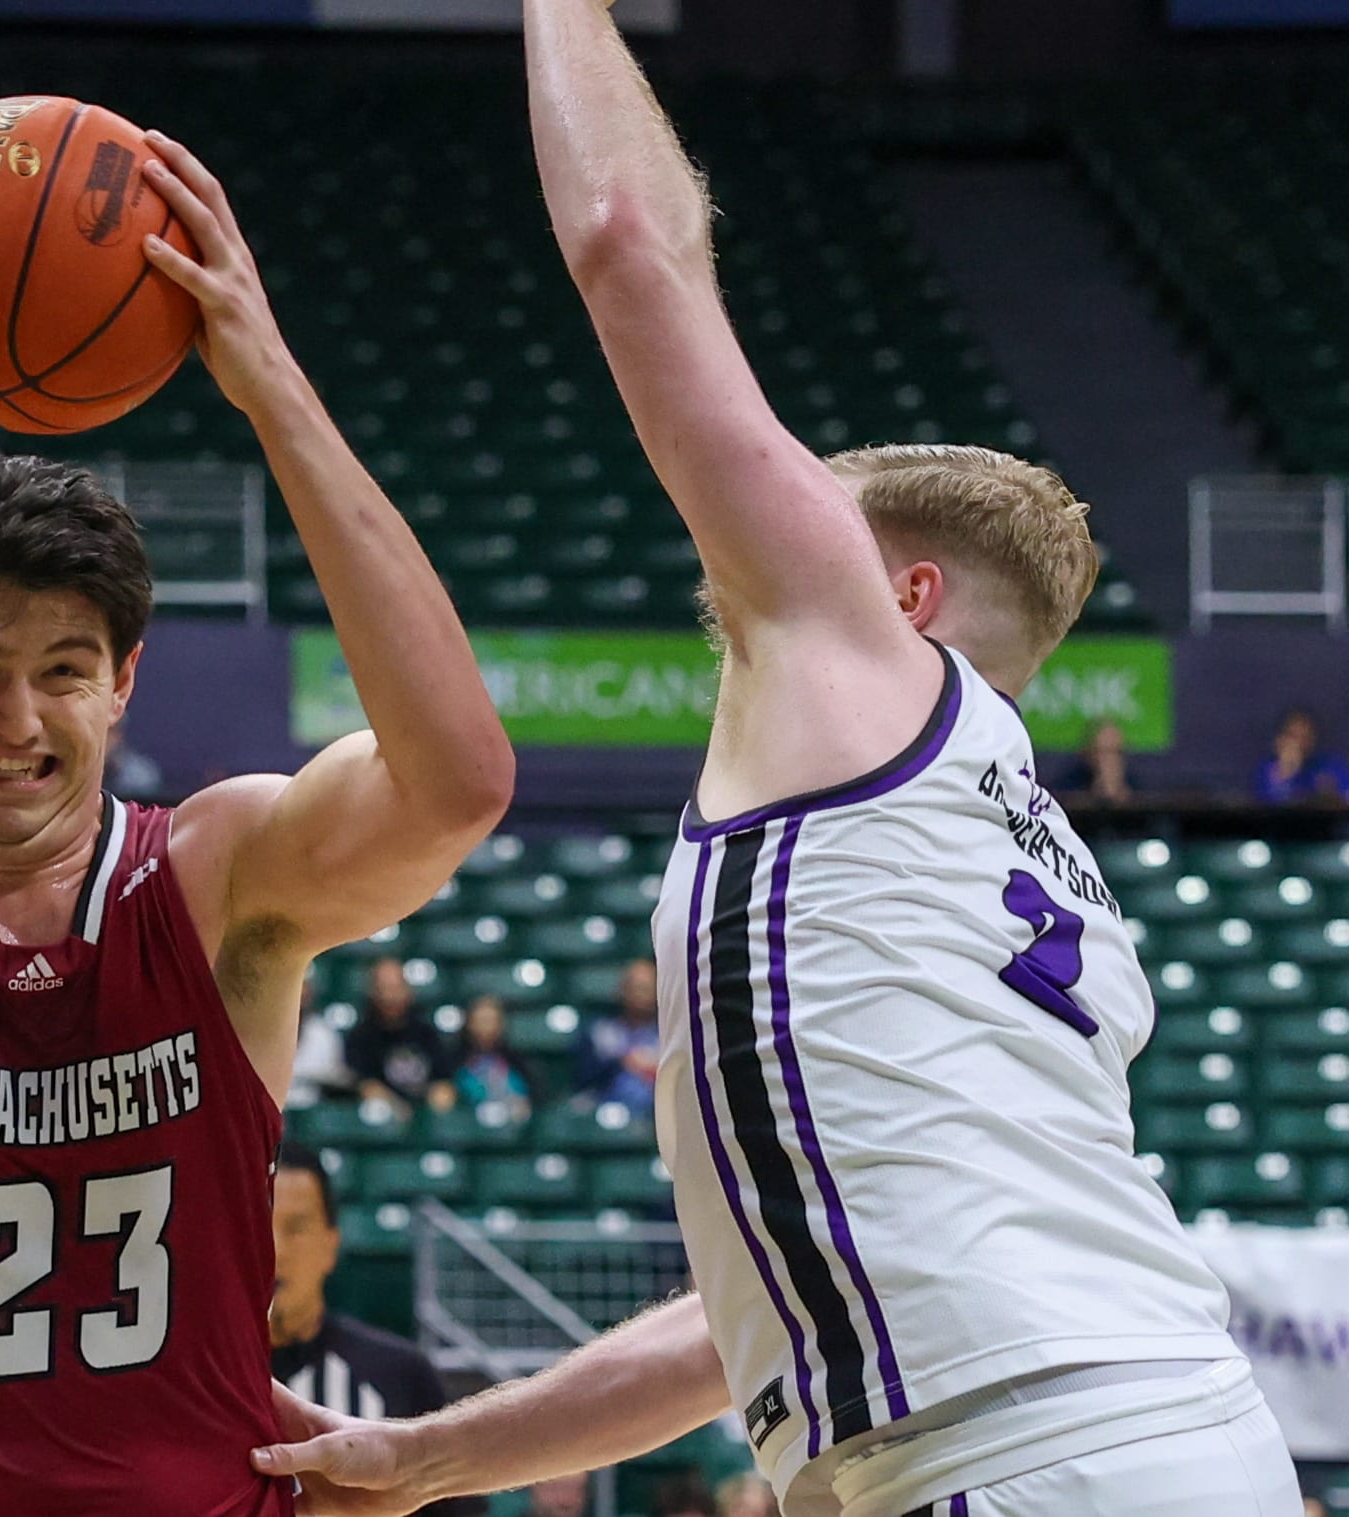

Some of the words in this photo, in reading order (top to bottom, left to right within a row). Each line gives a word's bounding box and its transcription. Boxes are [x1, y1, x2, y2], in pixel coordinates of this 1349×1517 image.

[1019, 666, 1143, 720] ANK
[998, 868, 1100, 1039] 2
[8, 976, 64, 992] adidas
[764, 1395, 779, 1416] XL
